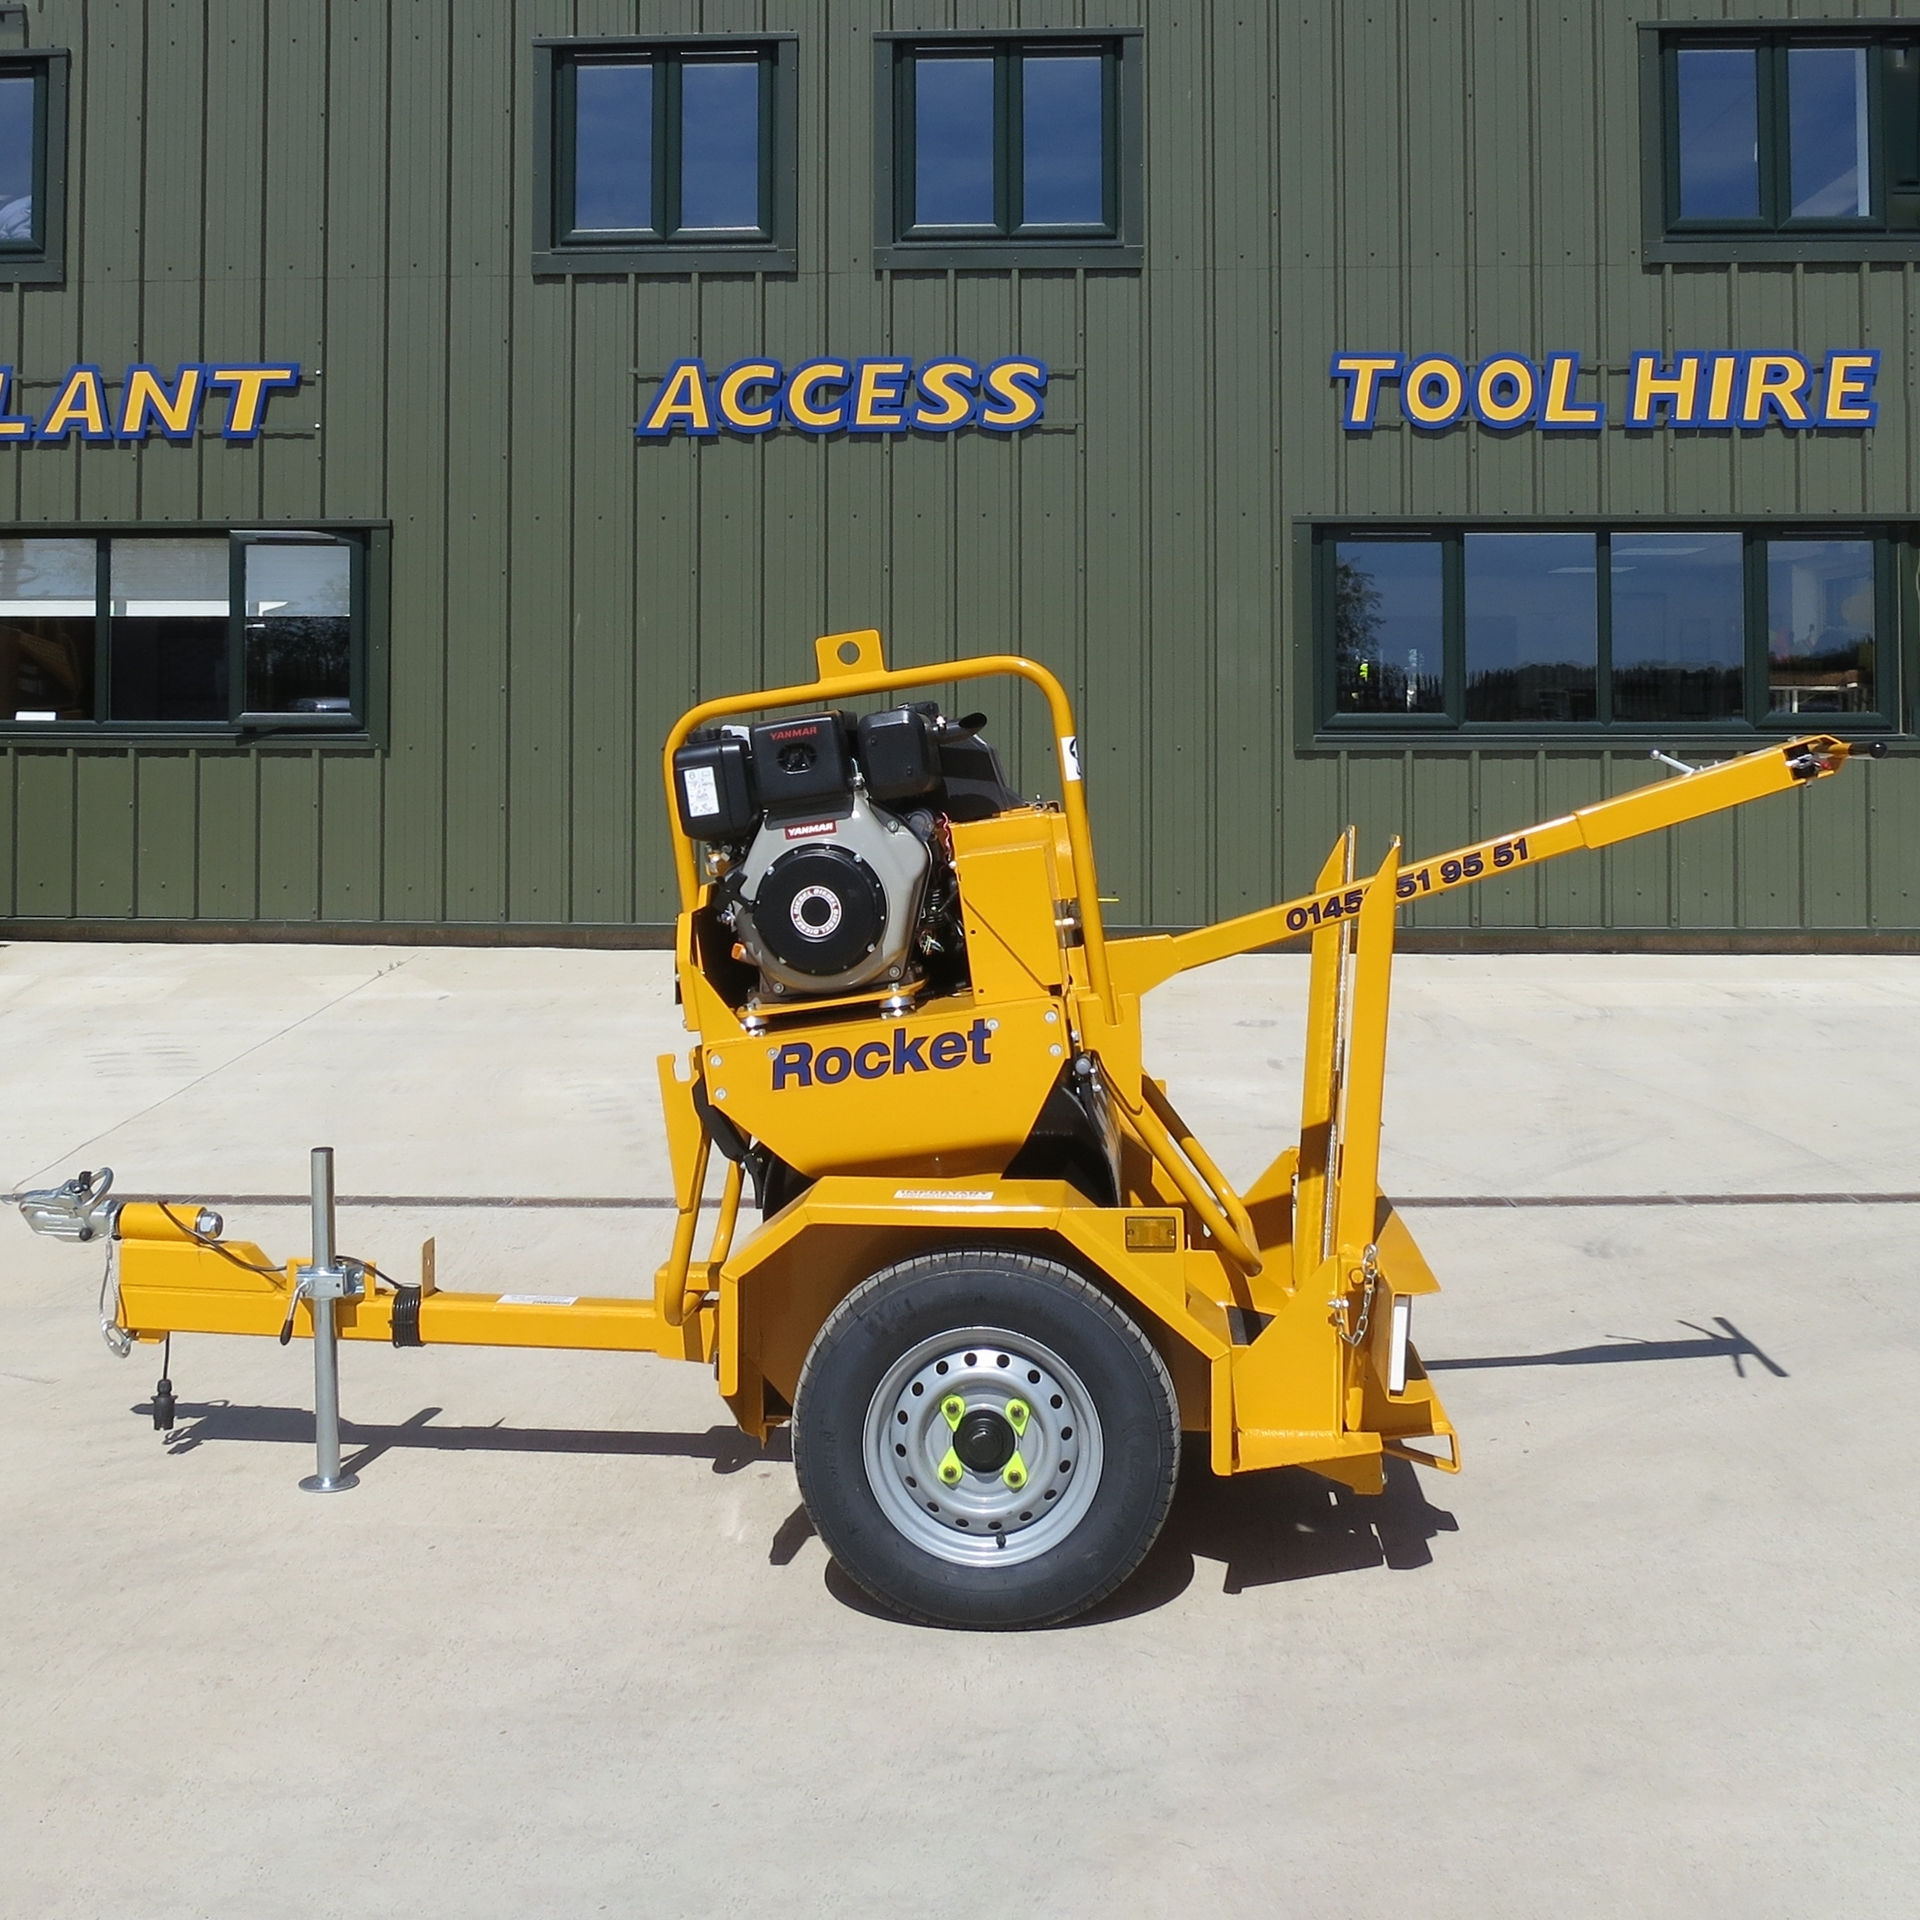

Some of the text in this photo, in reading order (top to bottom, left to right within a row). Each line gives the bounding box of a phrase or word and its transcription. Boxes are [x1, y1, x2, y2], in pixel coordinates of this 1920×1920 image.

[636, 355, 1047, 436] ACCESS
[1331, 349, 1881, 430] TOOL HIRE
[770, 726, 817, 740] YANMAR
[787, 822, 833, 837] YANMAR
[1286, 837, 1529, 931] 0145 51 95 51
[772, 1019, 991, 1090] Rocket
